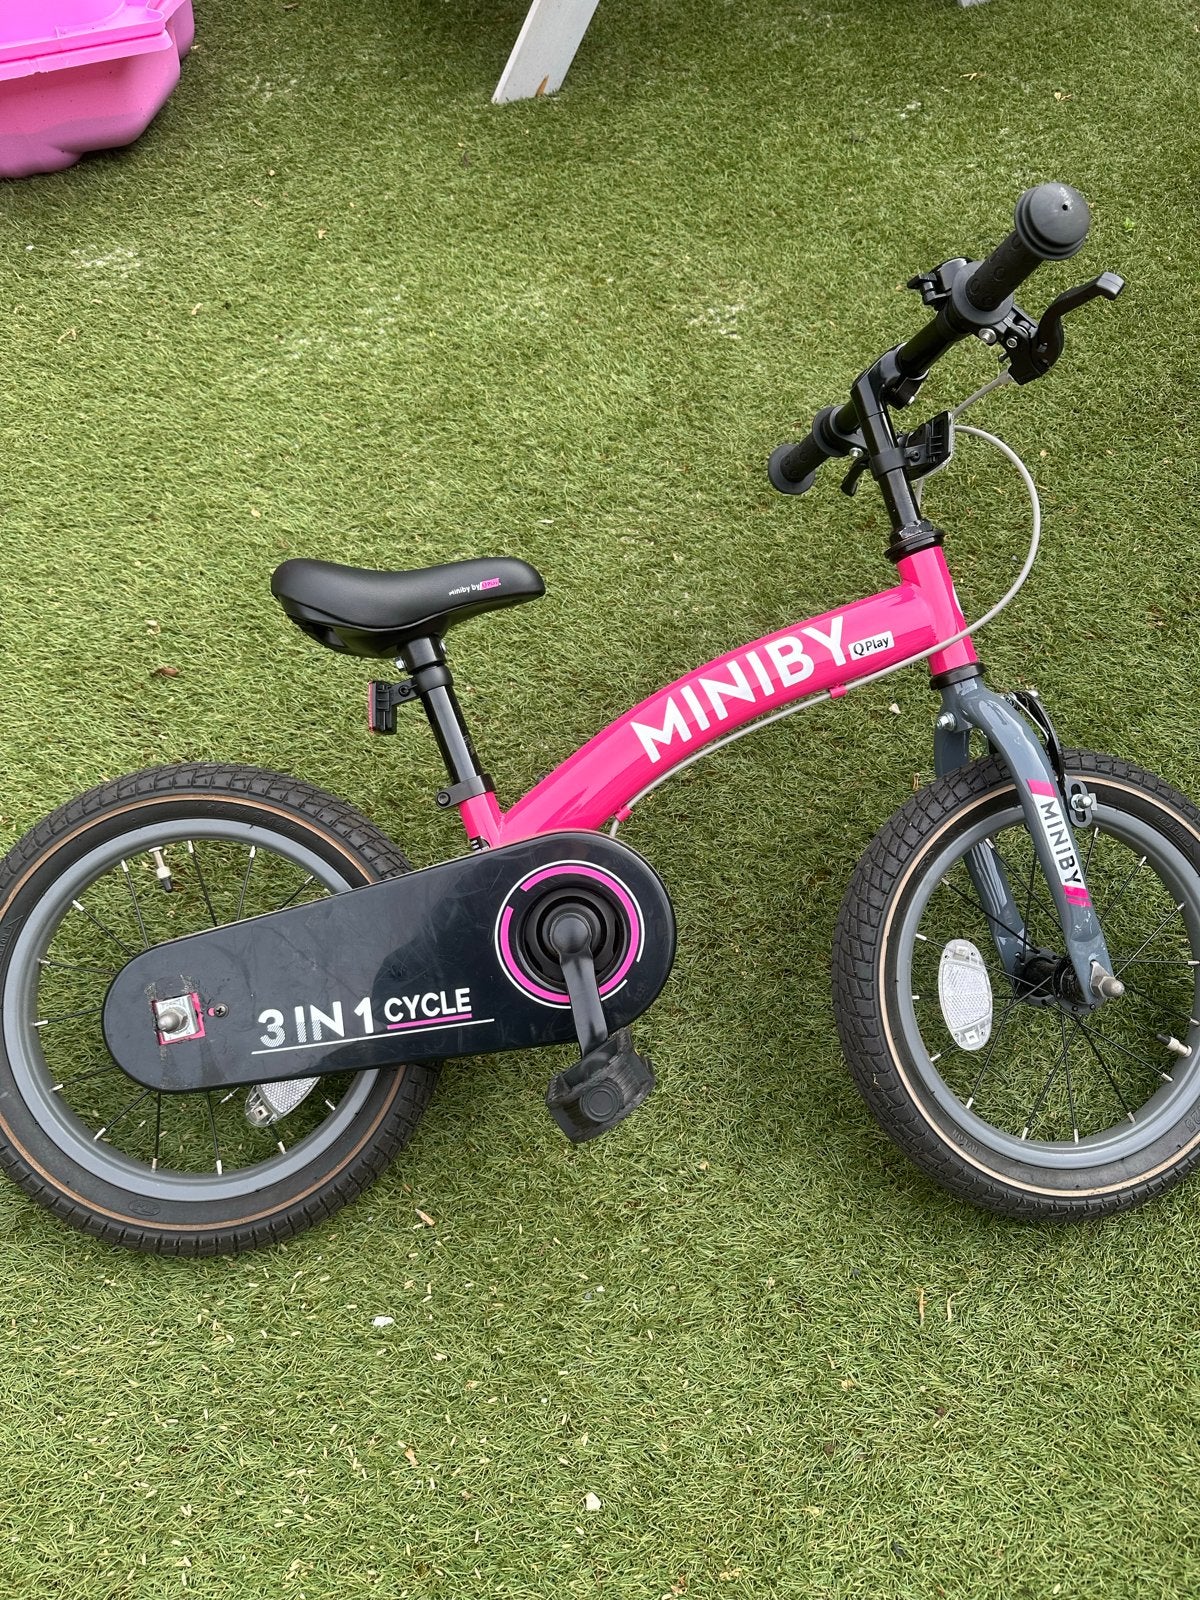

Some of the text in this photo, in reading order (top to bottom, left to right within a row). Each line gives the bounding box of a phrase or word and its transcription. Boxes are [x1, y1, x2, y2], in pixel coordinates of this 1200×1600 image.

[630, 616, 843, 763] MINIBY
[1040, 800, 1081, 883] MINIBY
[257, 987, 472, 1048] 3 IN 1 CYCLE
